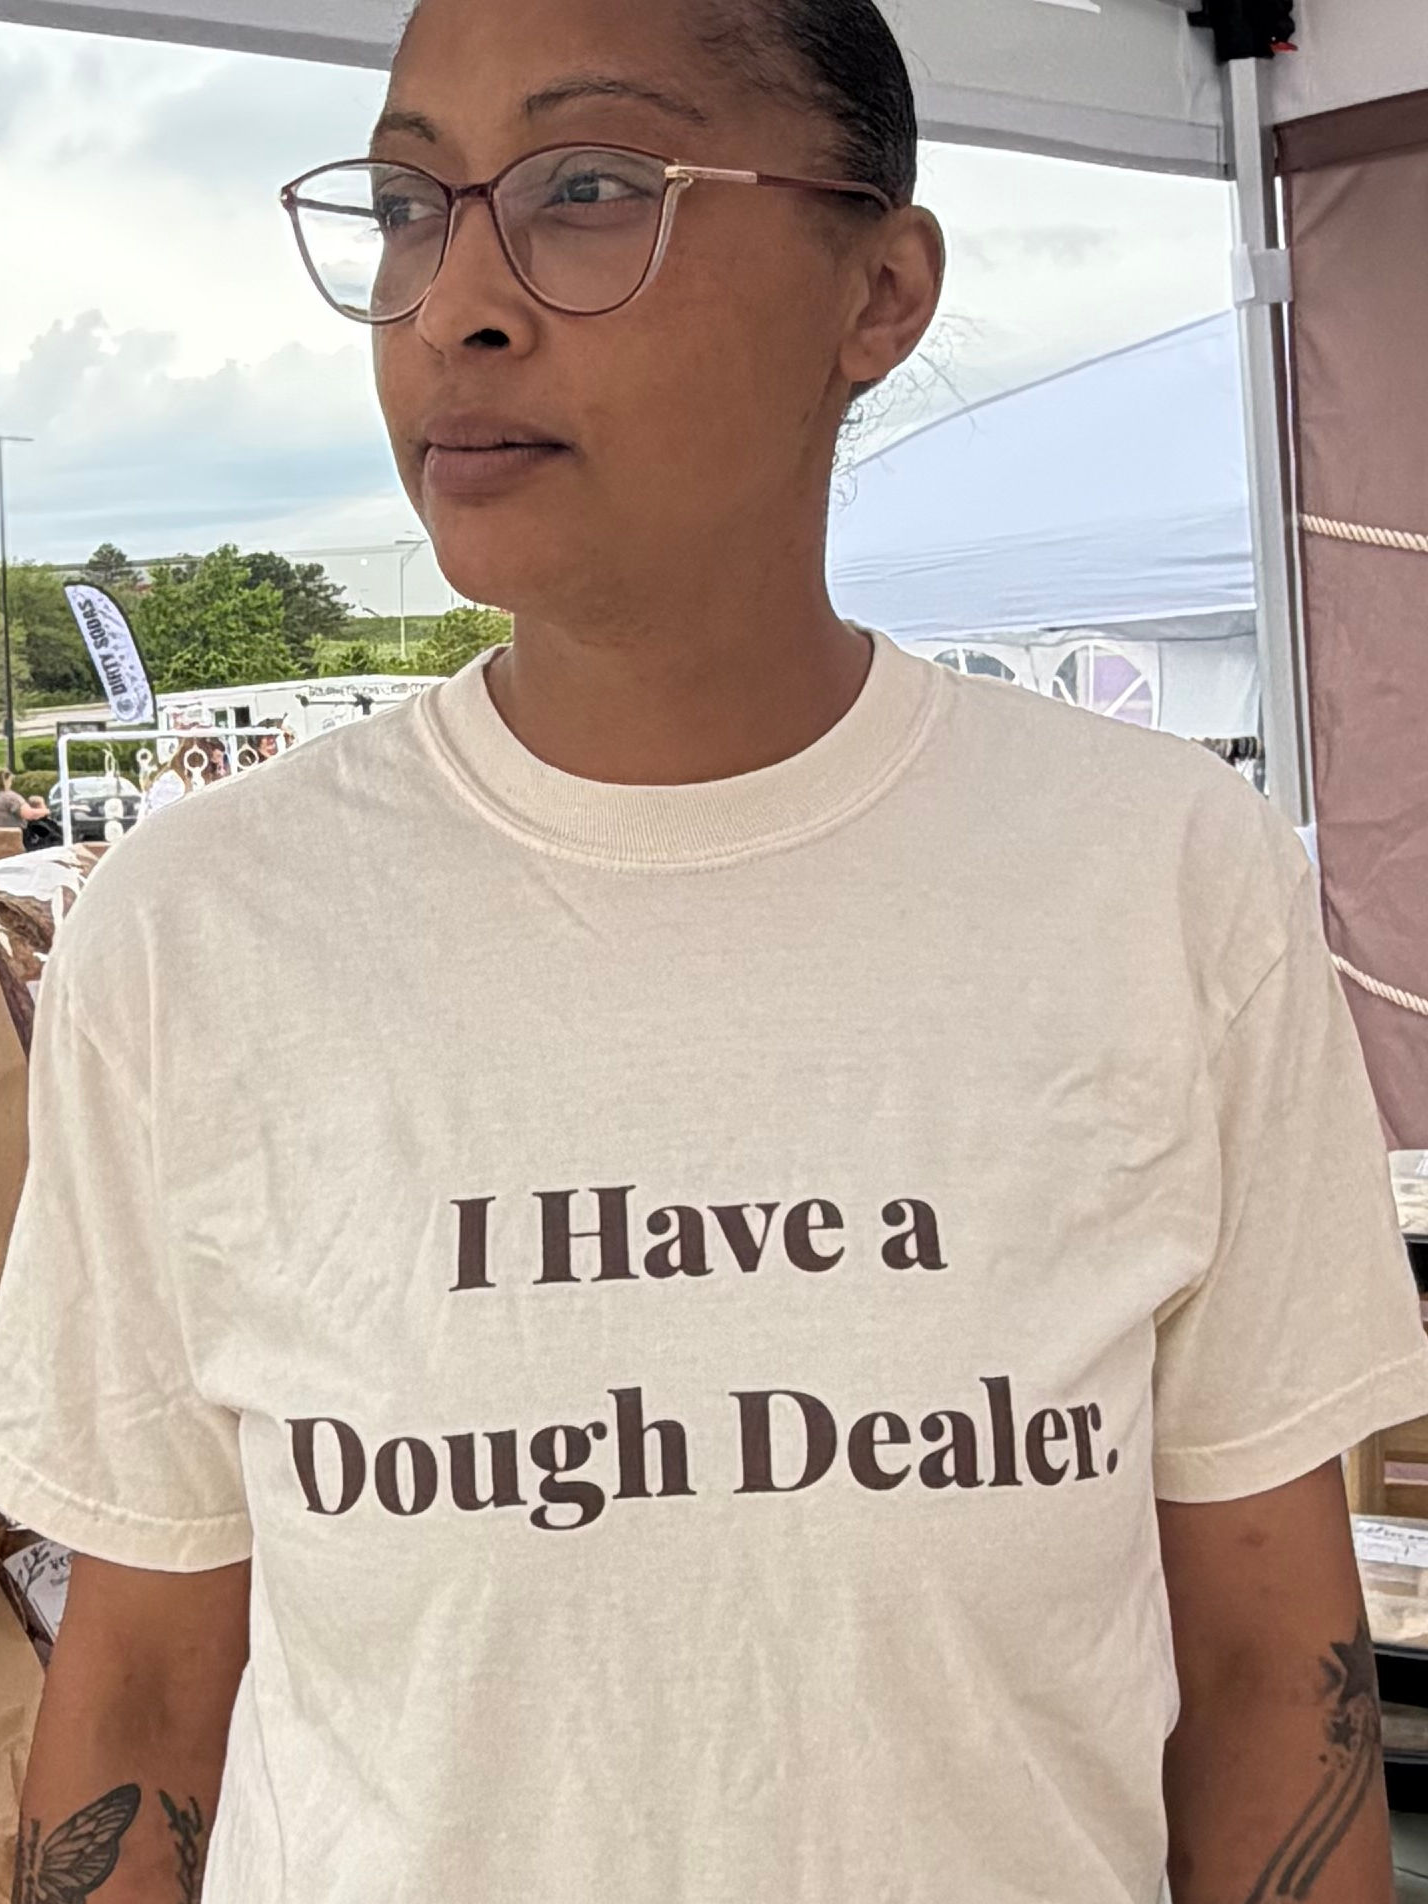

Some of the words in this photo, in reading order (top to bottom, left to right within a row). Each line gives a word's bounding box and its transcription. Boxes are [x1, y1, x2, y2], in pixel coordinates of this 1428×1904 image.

[448, 1196, 497, 1292] I
[531, 1185, 845, 1287] Have
[881, 1198, 948, 1272] a
[285, 1387, 697, 1531] Dough
[729, 1376, 1119, 1495] Dealer.
